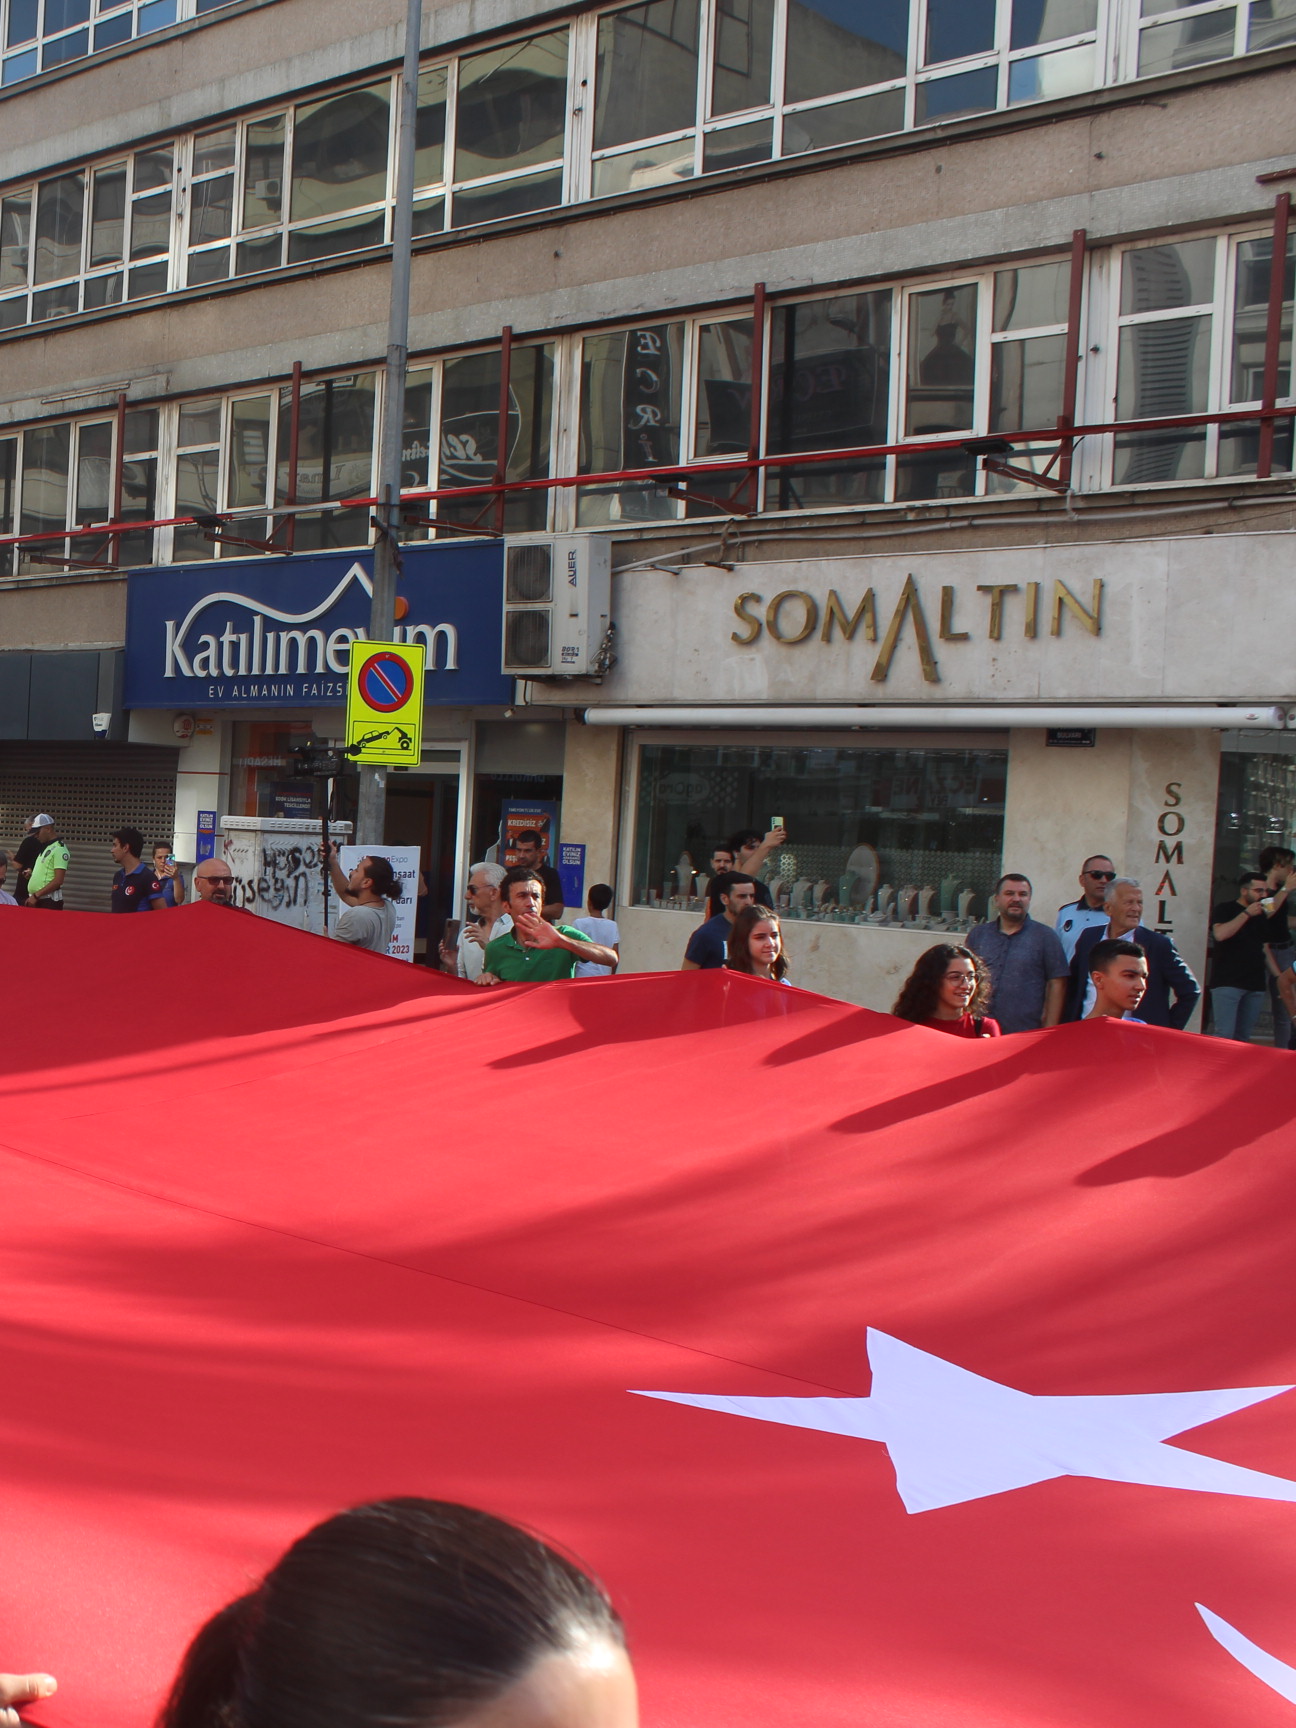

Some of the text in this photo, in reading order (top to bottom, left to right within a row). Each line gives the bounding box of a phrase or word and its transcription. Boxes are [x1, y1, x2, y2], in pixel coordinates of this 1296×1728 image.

[568, 549, 577, 588] AUER
[731, 573, 1103, 682] SOMALTIN
[209, 685, 224, 698] EV
[232, 684, 295, 698] ALMANIN
[391, 945, 410, 954] 2023
